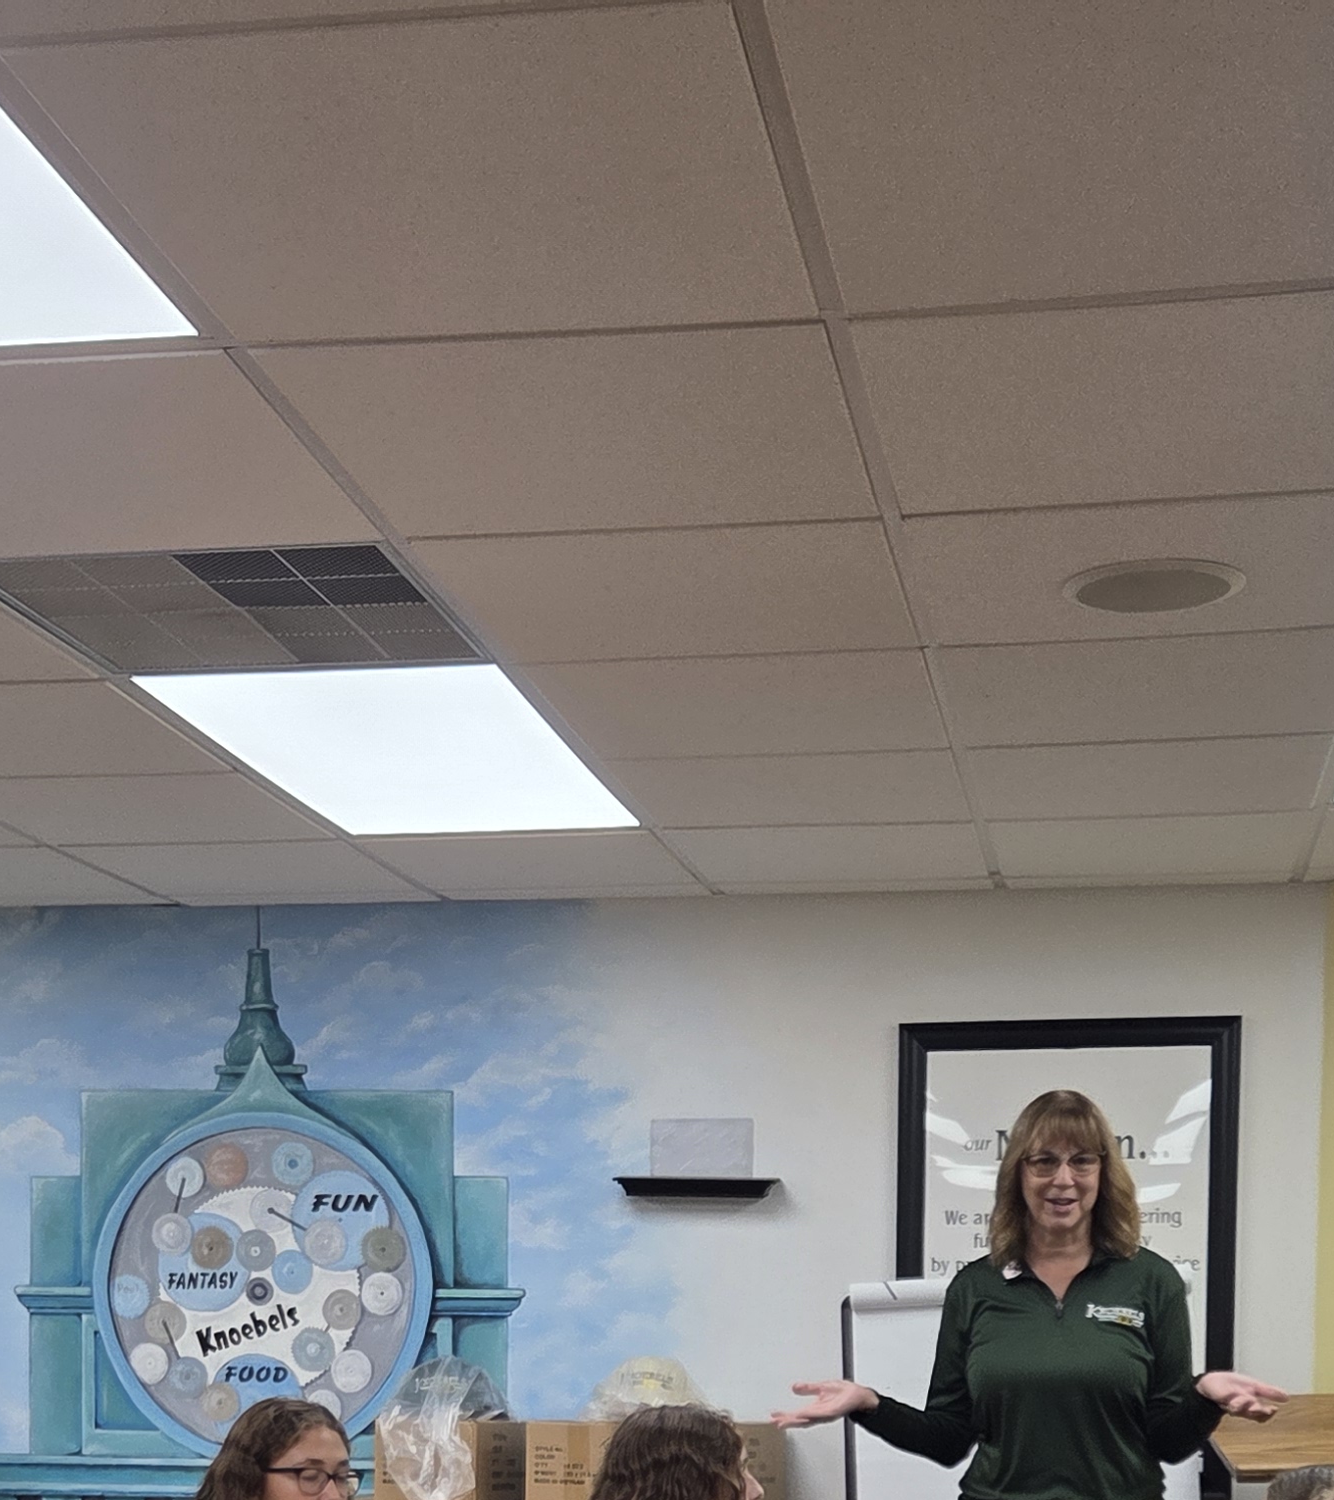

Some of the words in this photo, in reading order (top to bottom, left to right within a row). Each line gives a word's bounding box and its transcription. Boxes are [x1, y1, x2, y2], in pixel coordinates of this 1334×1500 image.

[311, 1194, 379, 1213] FUN
[944, 1210, 968, 1225] We
[930, 1257, 950, 1276] by
[168, 1271, 238, 1290] FANTASY
[196, 1303, 300, 1357] Knoebels
[224, 1366, 288, 1383] FOOD
